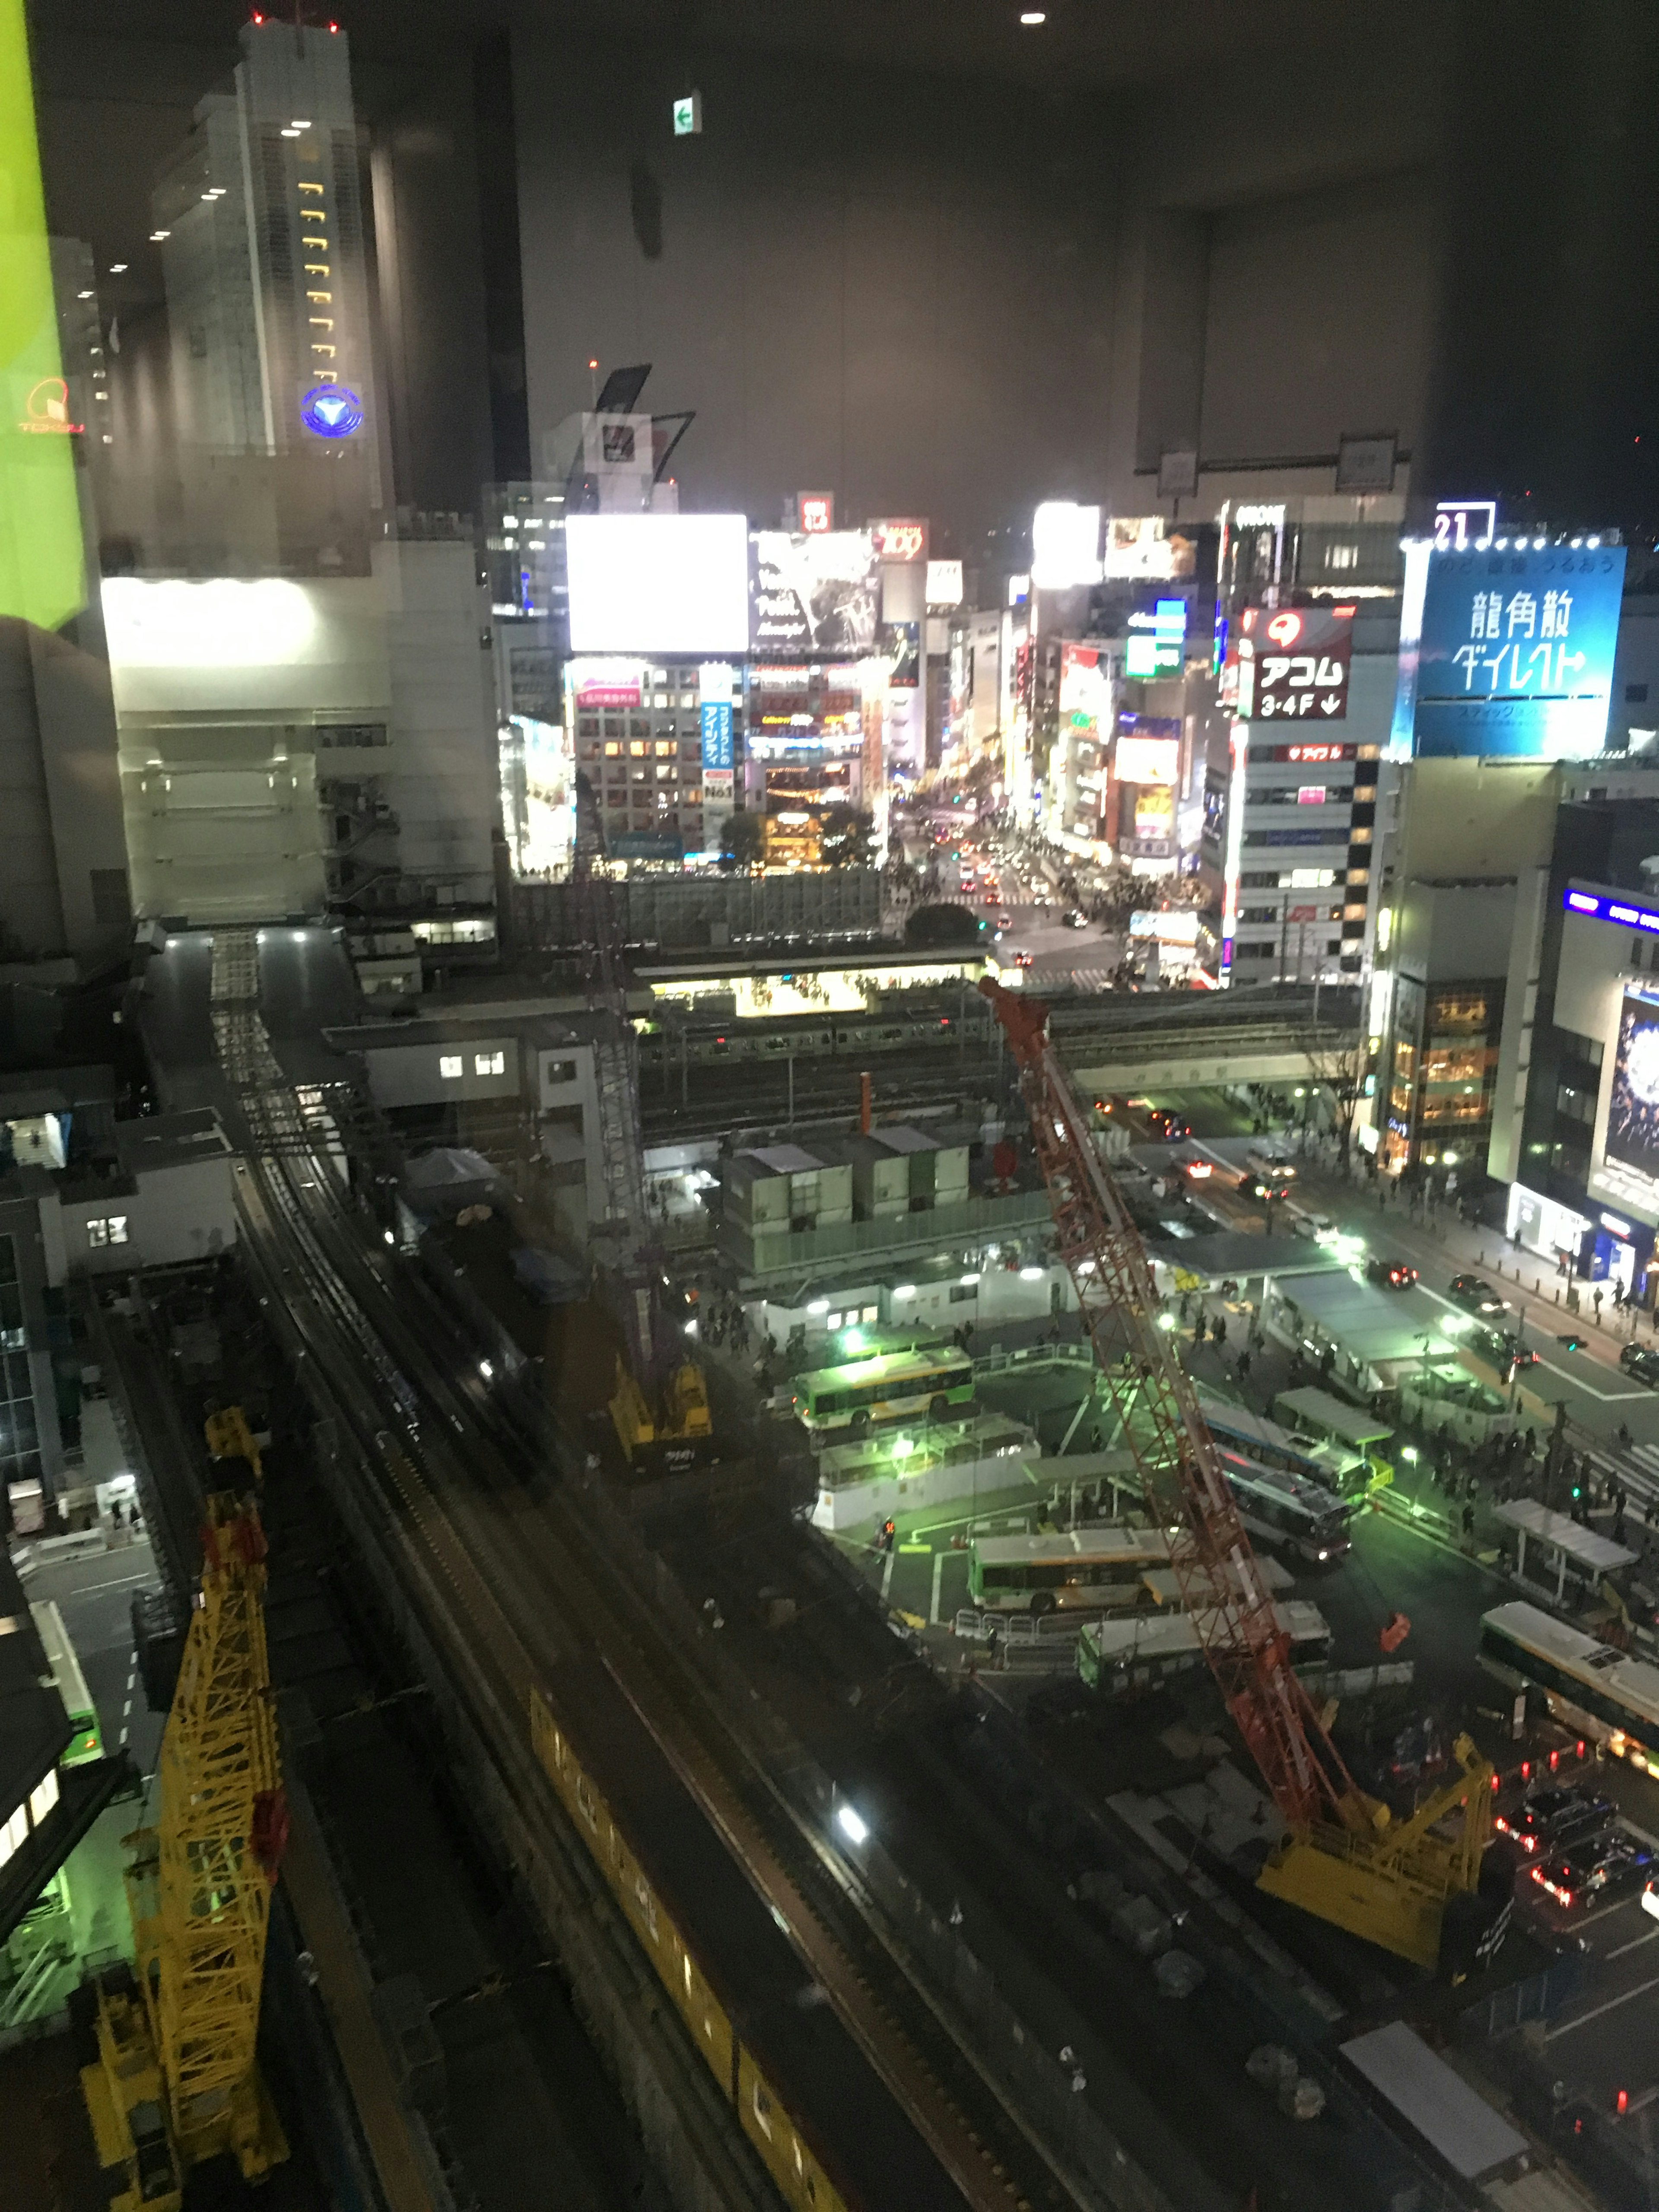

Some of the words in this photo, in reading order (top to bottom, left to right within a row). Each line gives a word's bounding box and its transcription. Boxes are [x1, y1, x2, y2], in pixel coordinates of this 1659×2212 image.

[879, 531, 923, 560] 109
[1434, 512, 1468, 550] 21
[1471, 590, 1573, 639] 龍角散
[1261, 657, 1343, 687] アコム
[1452, 643, 1586, 690] ダイレクト
